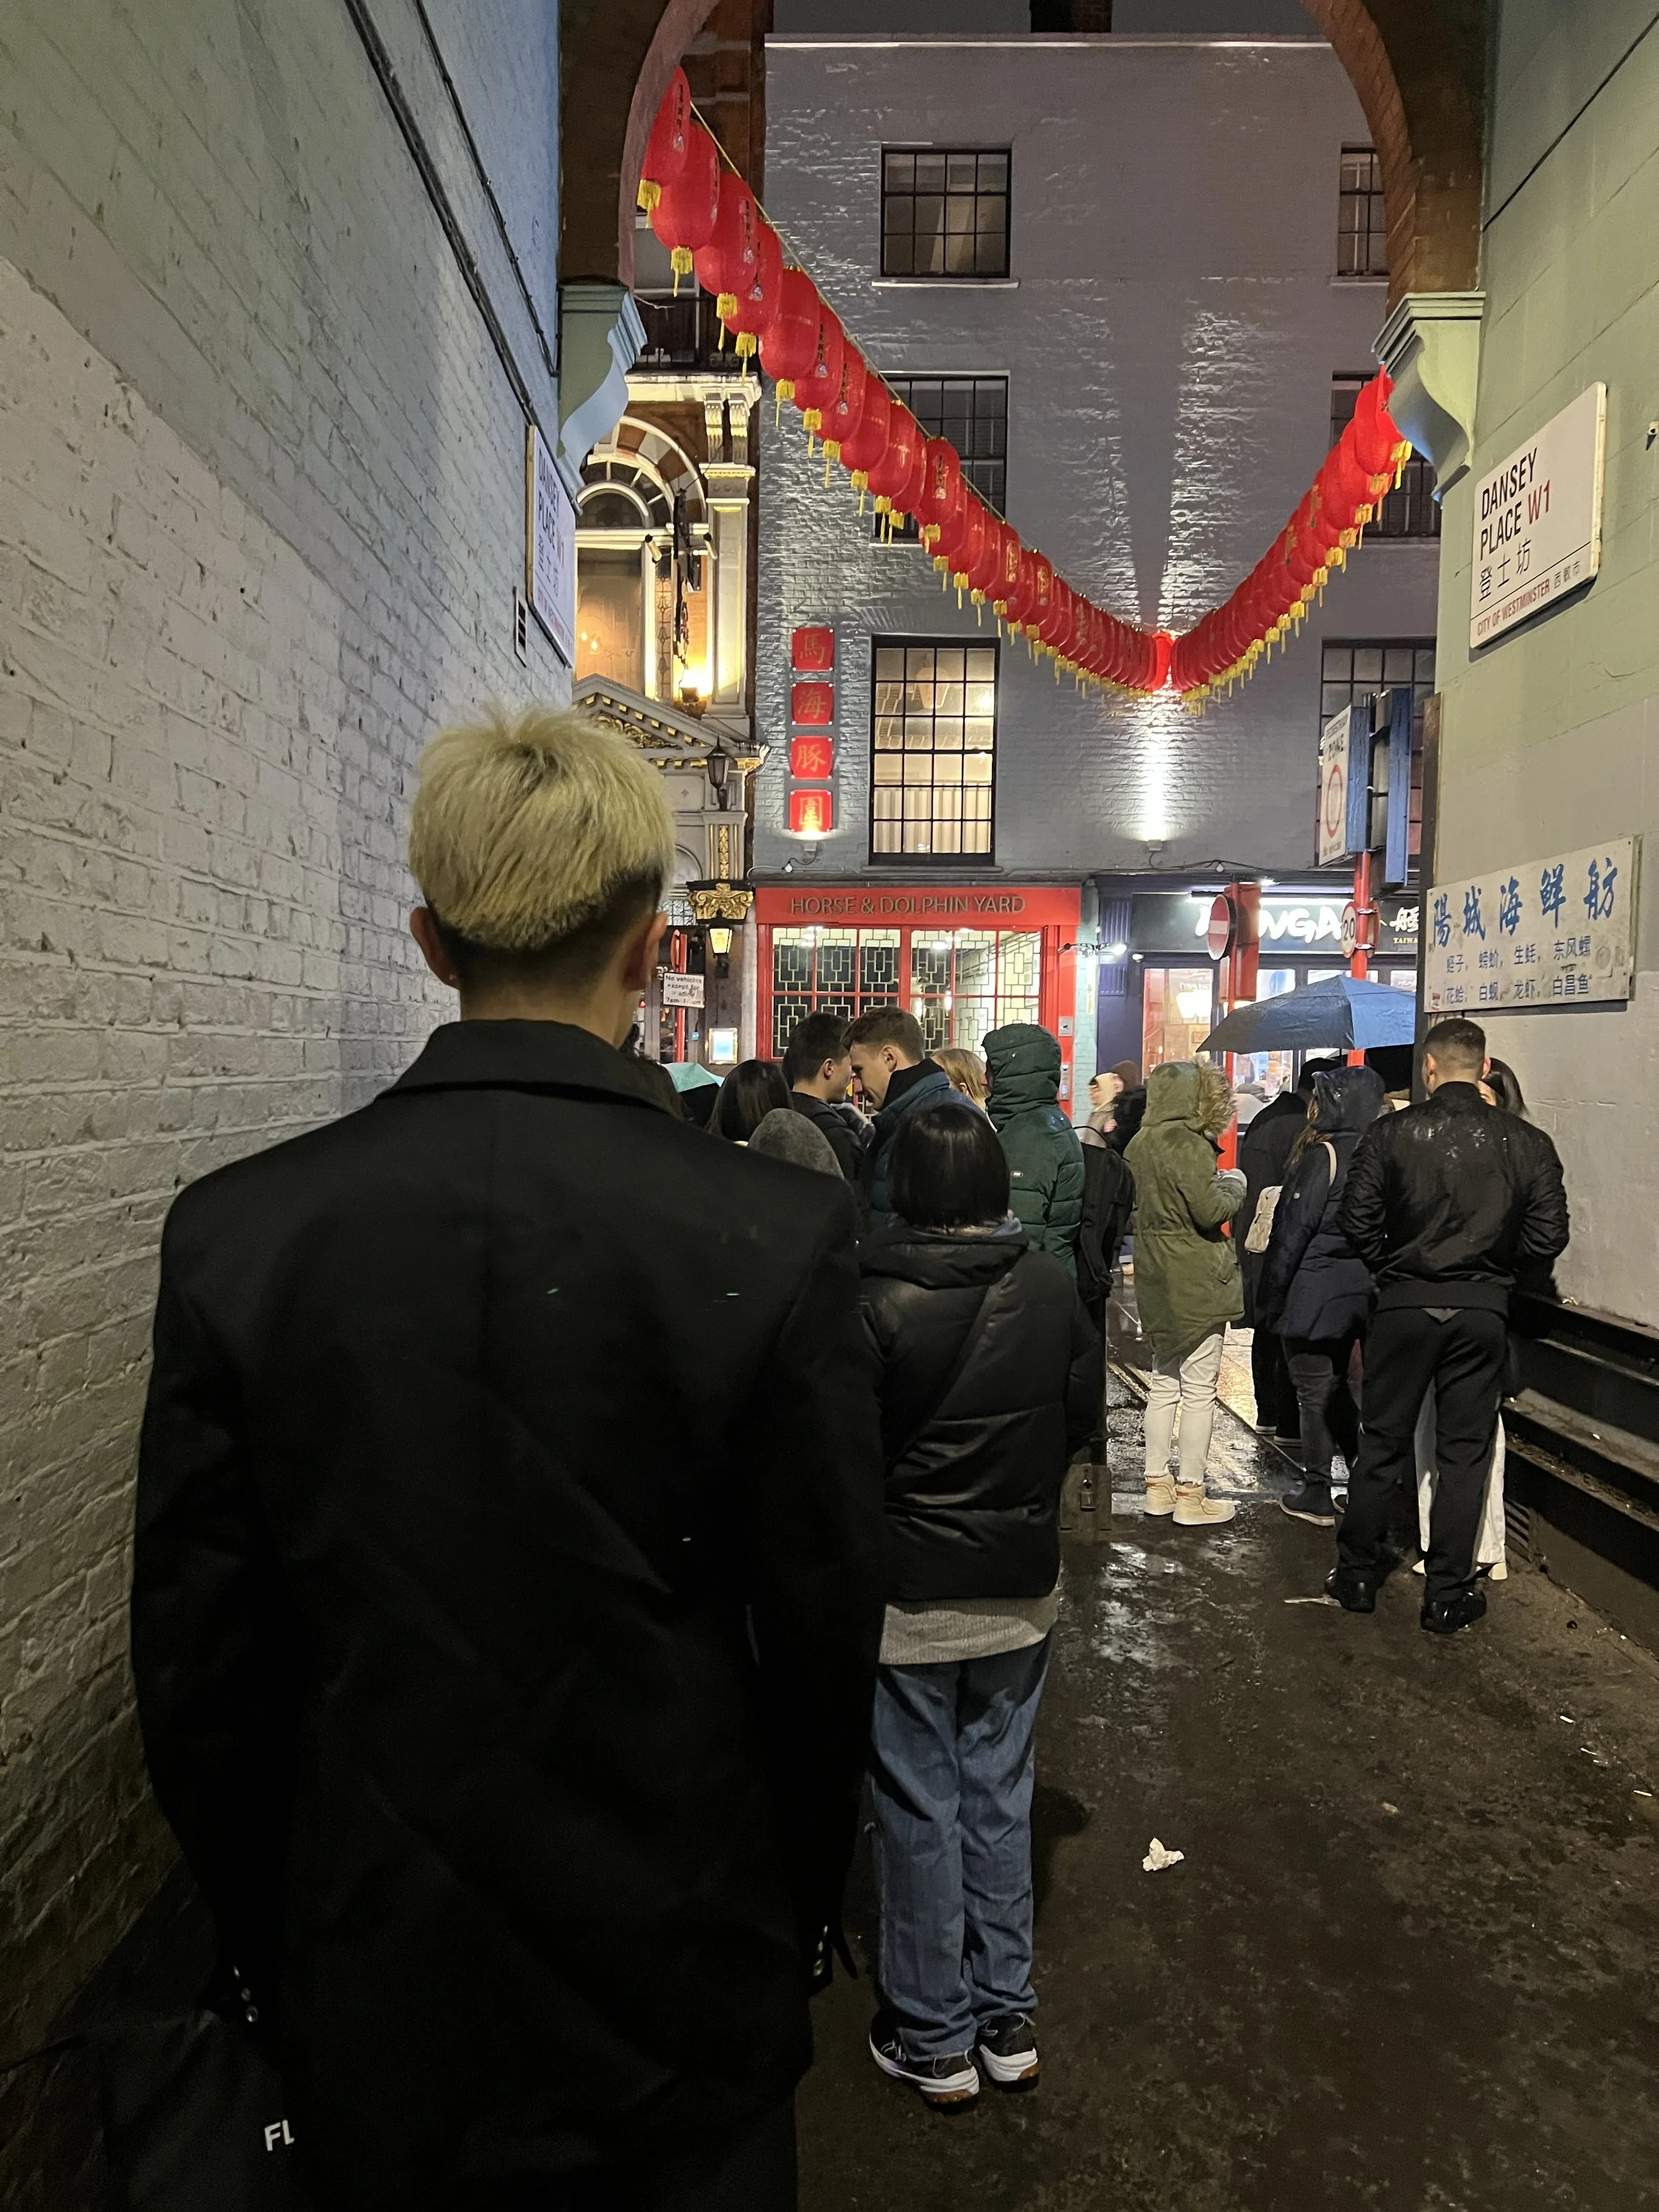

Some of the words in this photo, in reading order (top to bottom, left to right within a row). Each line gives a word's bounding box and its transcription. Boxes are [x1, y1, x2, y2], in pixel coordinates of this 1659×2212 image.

[1480, 447, 1538, 521] DANSEY
[1479, 500, 1523, 561] PLACE
[1528, 479, 1551, 525] W1
[1479, 538, 1532, 602] 登士坊
[1477, 616, 1492, 636] CITY
[1492, 609, 1501, 627] OF
[1502, 579, 1550, 621] WESTMINSTER
[790, 896, 856, 915] HORSE
[862, 896, 875, 914] &
[880, 895, 970, 914] DOLPHIN
[973, 895, 1027, 914] YARD
[1343, 919, 1355, 941] 20
[1433, 857, 1619, 948] 陽城海鮮舫
